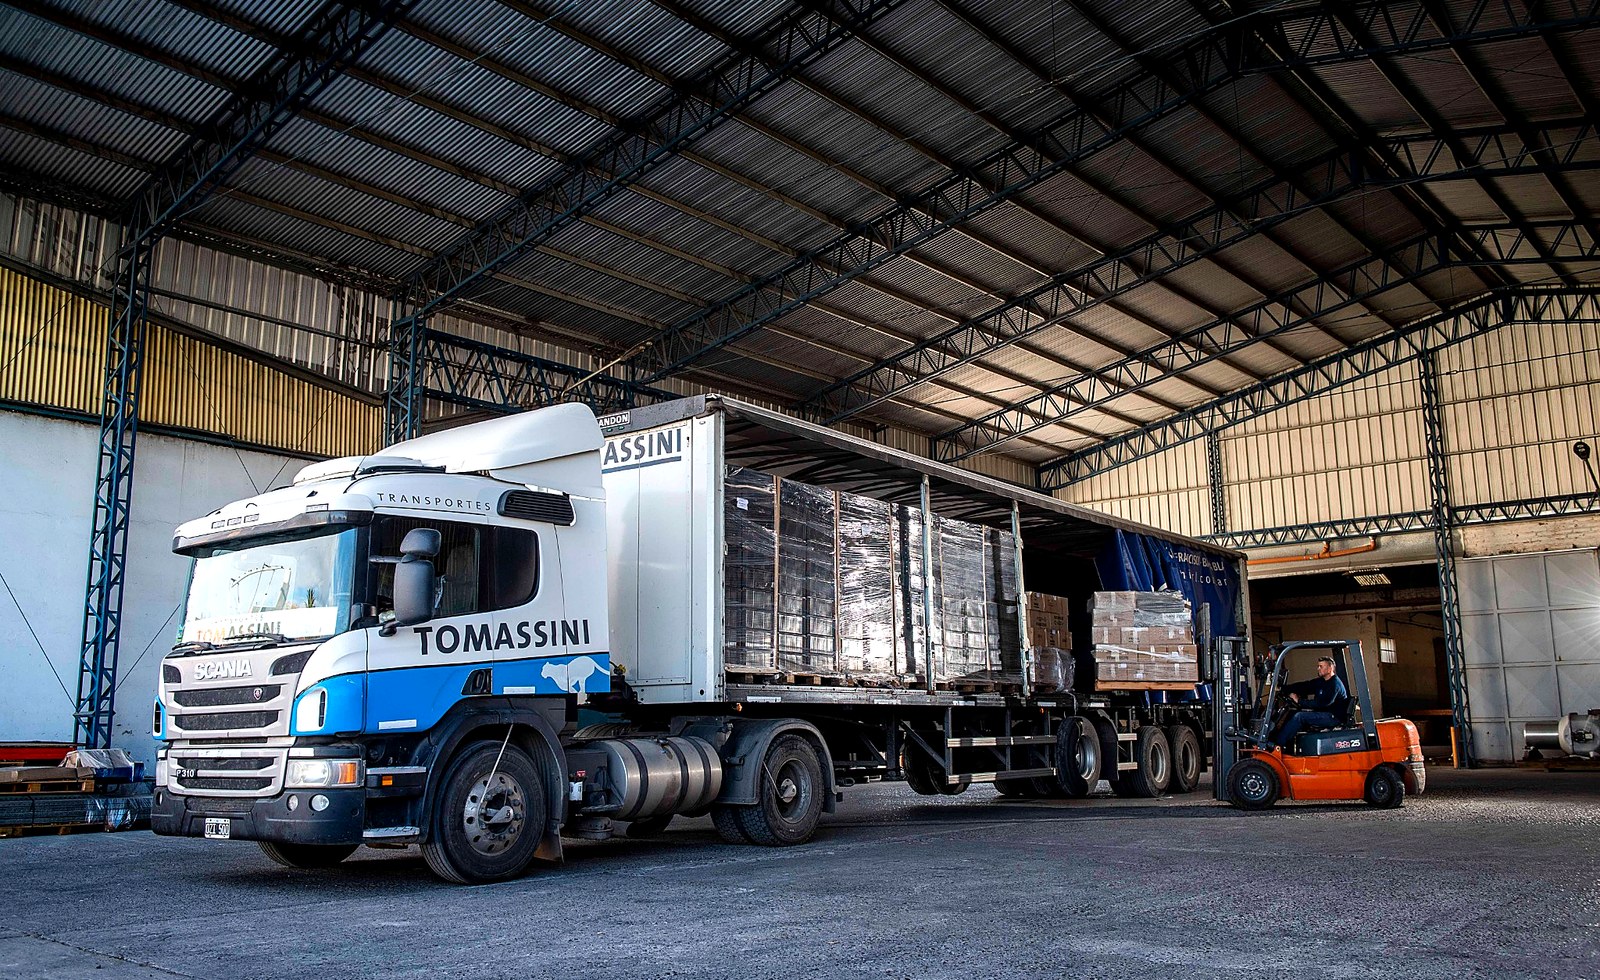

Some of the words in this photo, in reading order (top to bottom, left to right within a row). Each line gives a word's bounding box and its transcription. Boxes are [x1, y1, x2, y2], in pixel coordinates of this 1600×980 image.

[603, 428, 682, 465] ASSINI
[377, 493, 491, 511] TRANSPORTES
[413, 619, 590, 655] TOMASSINI
[194, 659, 253, 680] SCANIA
[1350, 739, 1361, 748] 25
